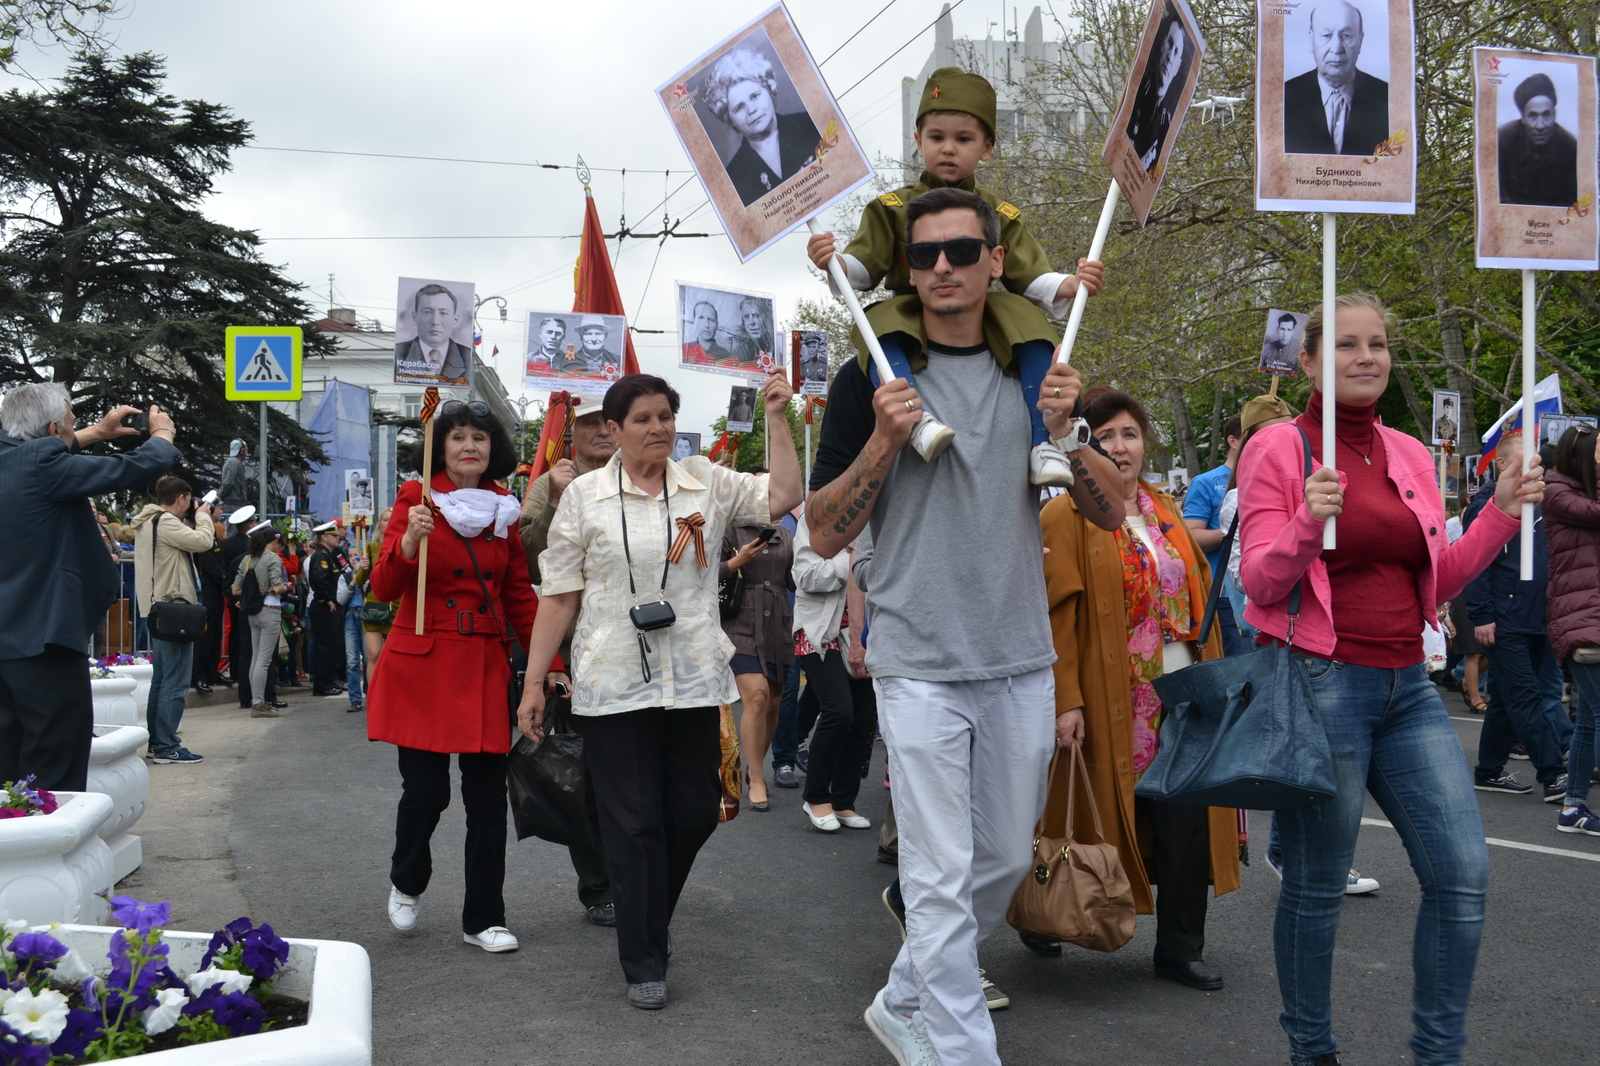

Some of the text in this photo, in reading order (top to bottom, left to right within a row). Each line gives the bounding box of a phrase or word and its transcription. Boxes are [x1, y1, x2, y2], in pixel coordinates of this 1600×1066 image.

[1272, 8, 1292, 16] ПОЛК
[1315, 167, 1362, 178] Будников
[761, 166, 824, 211] Заболотникова
[1295, 178, 1382, 188] Никифор Парфенович
[763, 173, 830, 220] Надежда Яковлевна
[1527, 219, 1551, 230] Мусин
[396, 359, 441, 369] Карабасов
[833, 480, 880, 534] TEMPUS
